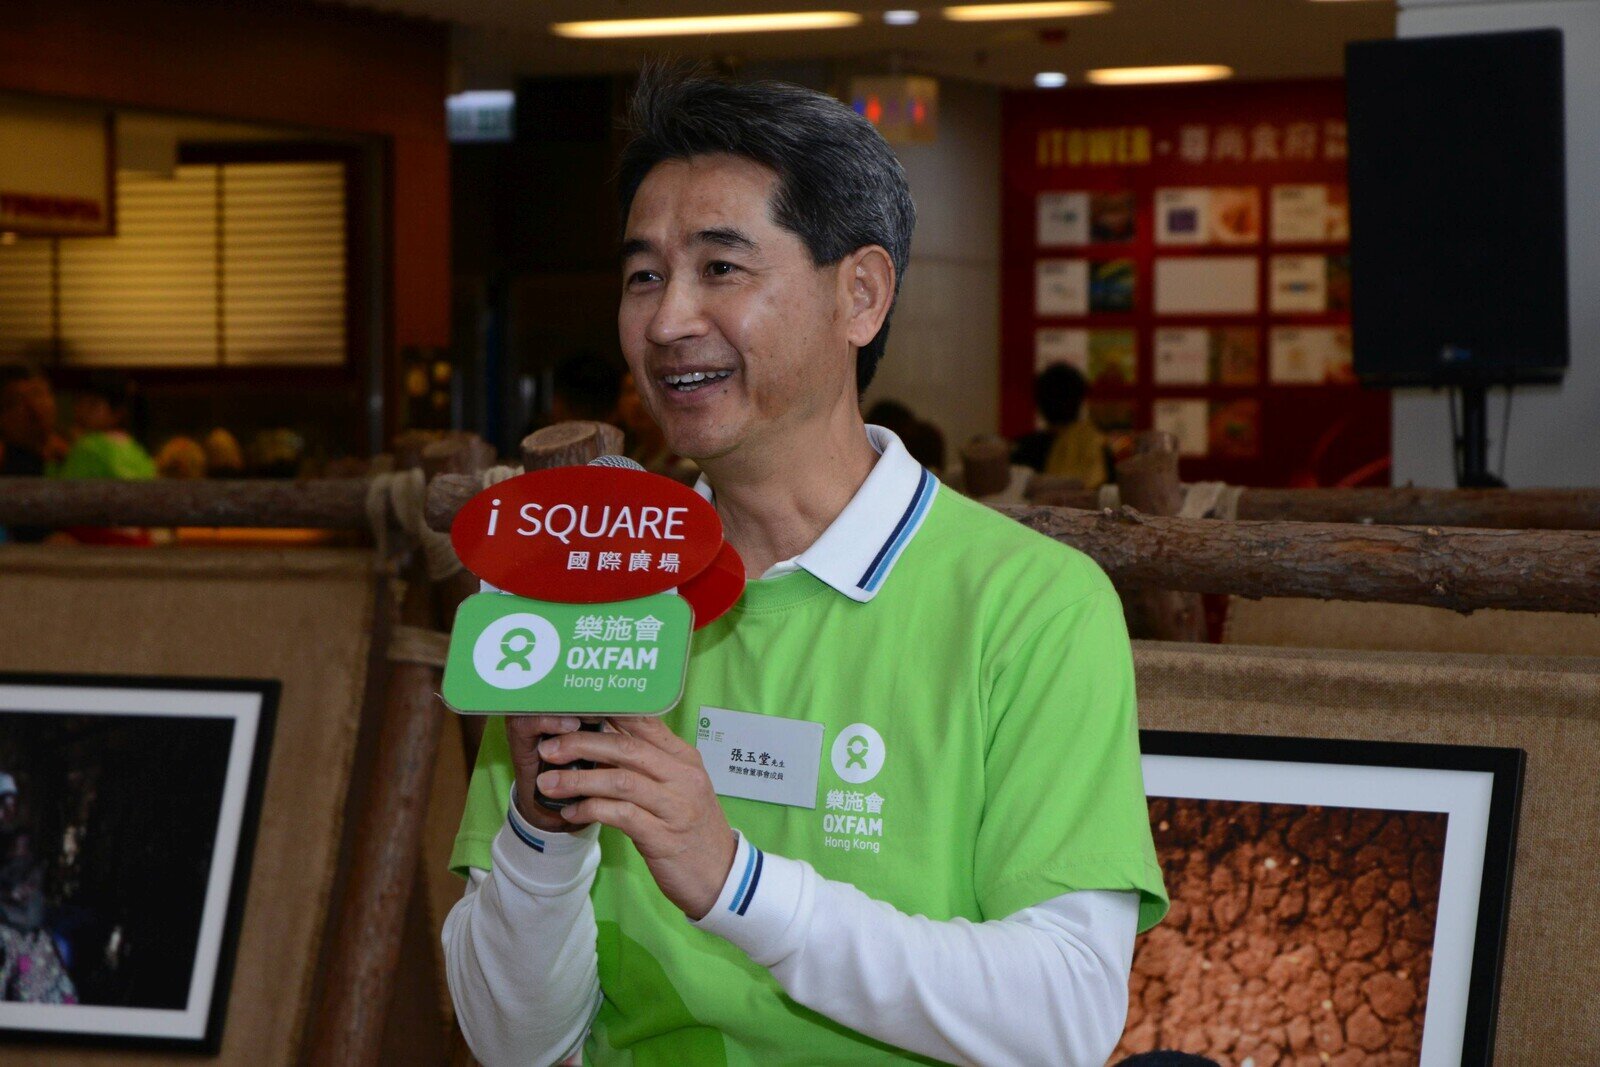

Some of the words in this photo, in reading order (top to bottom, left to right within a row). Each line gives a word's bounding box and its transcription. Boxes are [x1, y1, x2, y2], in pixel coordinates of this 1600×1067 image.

[487, 498, 501, 536] i
[516, 503, 689, 544] SQUARE
[566, 550, 681, 573] 國際廣場
[572, 614, 665, 643] 樂施會
[566, 646, 659, 670] OXFAM
[563, 674, 604, 691] Hong
[607, 674, 647, 692] Kong
[825, 789, 885, 814] 樂施會
[822, 814, 883, 837] OXFAM
[824, 836, 850, 850] Hong
[853, 838, 880, 853] Kong
